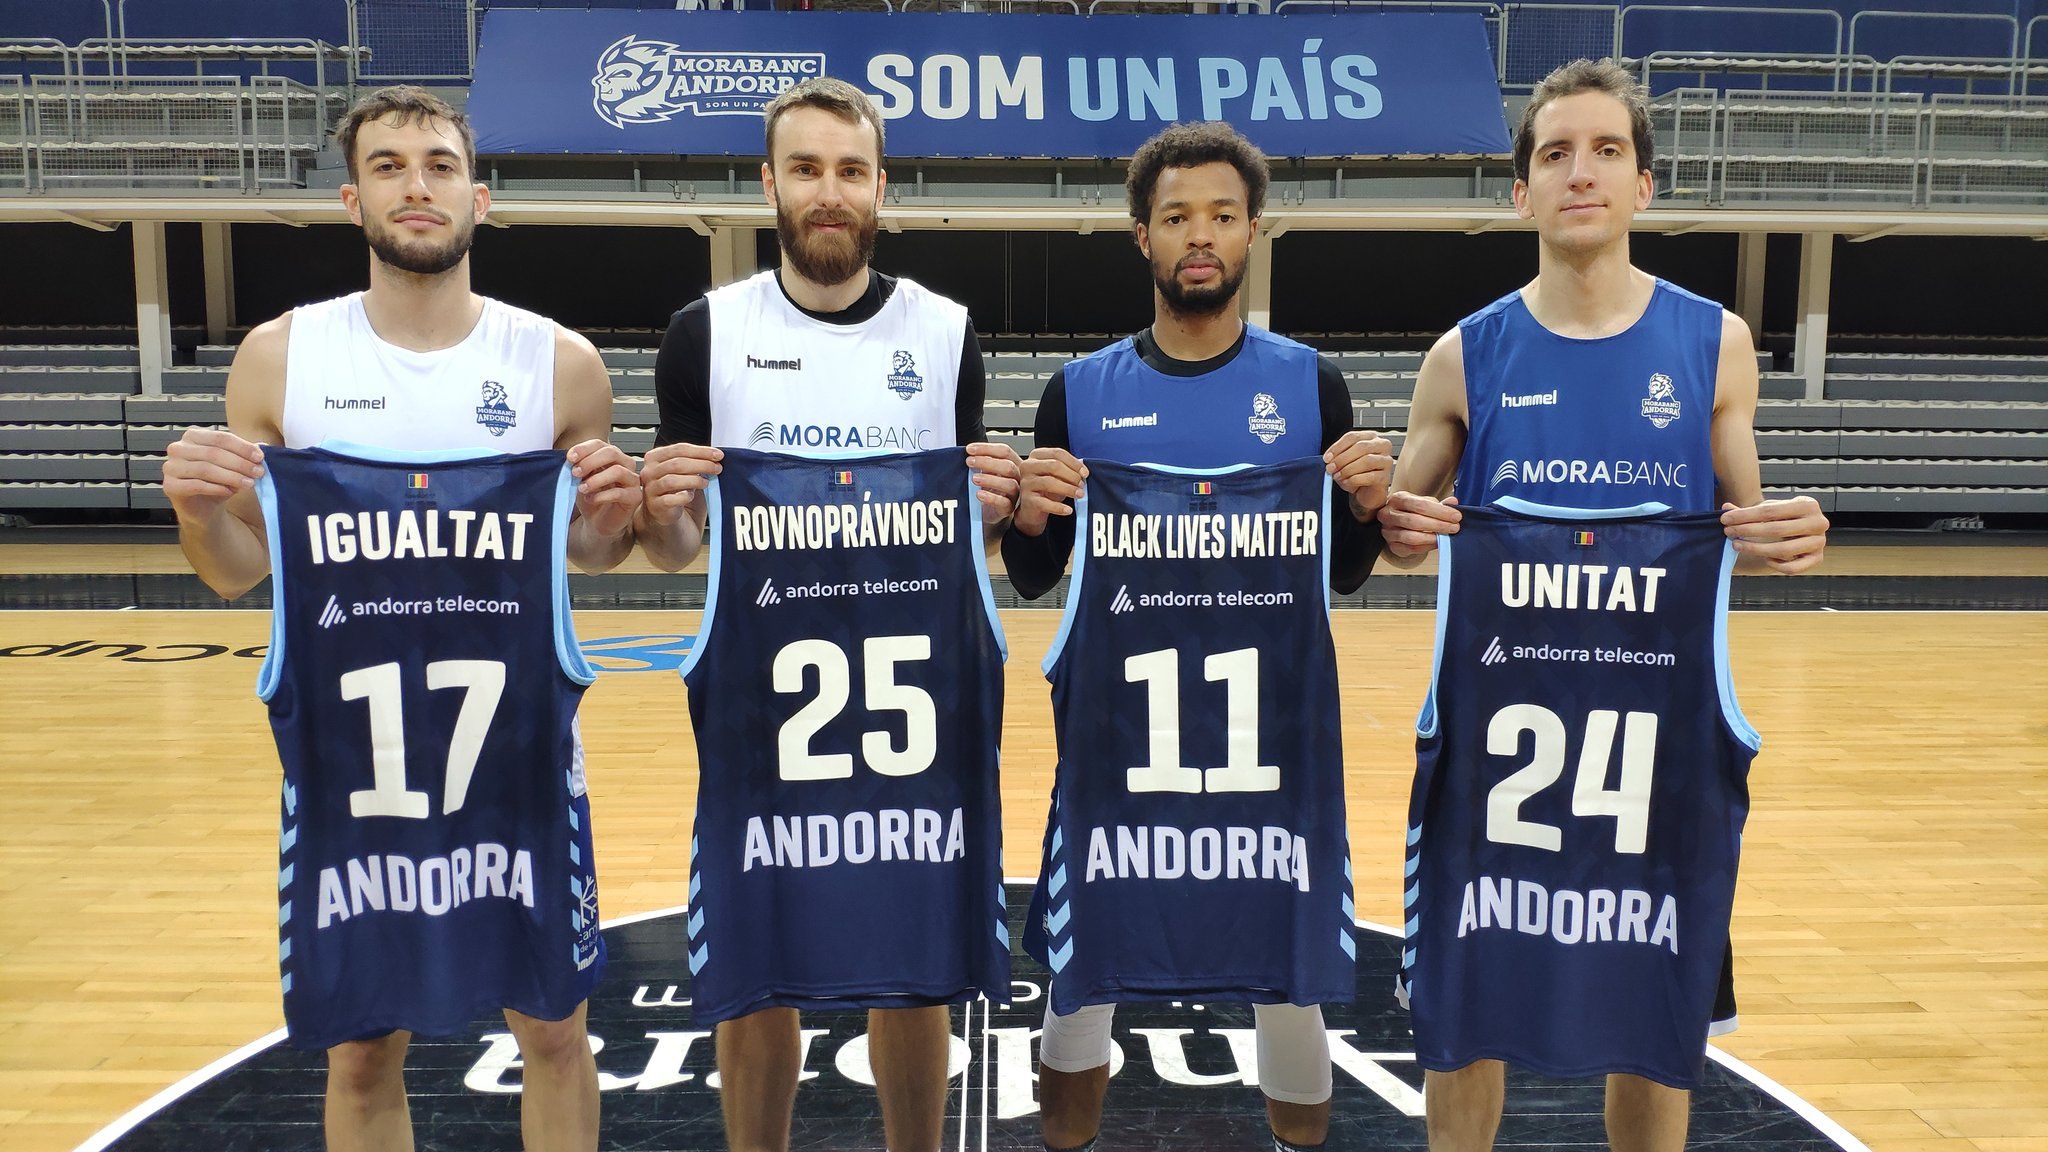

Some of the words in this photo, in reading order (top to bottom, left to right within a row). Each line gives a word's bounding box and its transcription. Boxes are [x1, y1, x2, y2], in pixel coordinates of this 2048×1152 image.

[672, 58, 817, 74] MORABANC
[670, 75, 811, 98] ANDORR
[866, 53, 1044, 120] SOM
[1068, 57, 1179, 121] UN
[1198, 38, 1384, 121] PAÍS
[705, 101, 729, 109] SOM
[747, 354, 801, 371] hummel
[889, 380, 922, 390] ANDORRA
[325, 396, 385, 410] hummel
[1501, 390, 1557, 408] hummel
[1643, 406, 1679, 416] ANDORRA
[477, 413, 516, 426] ANDORRA
[1102, 413, 1157, 430] hummel
[1250, 423, 1284, 432] ANDORRA
[780, 424, 931, 451] MORABANC
[1522, 460, 1688, 488] MORABANC
[733, 491, 959, 551] ROVNOPRÁVNOST
[307, 509, 534, 565] IGUALTAT
[1092, 513, 1162, 559] BLACK
[1166, 513, 1226, 559] LIVES
[1231, 511, 1319, 558] MATTER
[786, 579, 860, 599] andorra
[863, 576, 938, 596] telecom
[1139, 590, 1212, 607] andorra
[1217, 590, 1293, 606] telecom
[1501, 562, 1667, 613] UNITAT
[352, 597, 433, 616] andorra
[436, 595, 519, 614] telecom
[1512, 644, 1590, 662] andorra
[1594, 646, 1676, 666] telecom
[772, 635, 937, 781] 25
[1124, 647, 1281, 794] 11
[340, 659, 506, 819] 17
[1485, 703, 1659, 854] 24
[743, 807, 966, 872] ANDORRA
[1086, 825, 1310, 892] ANDORRA
[317, 842, 534, 929] ANDORRA
[1457, 876, 1679, 956] ANDORRA
